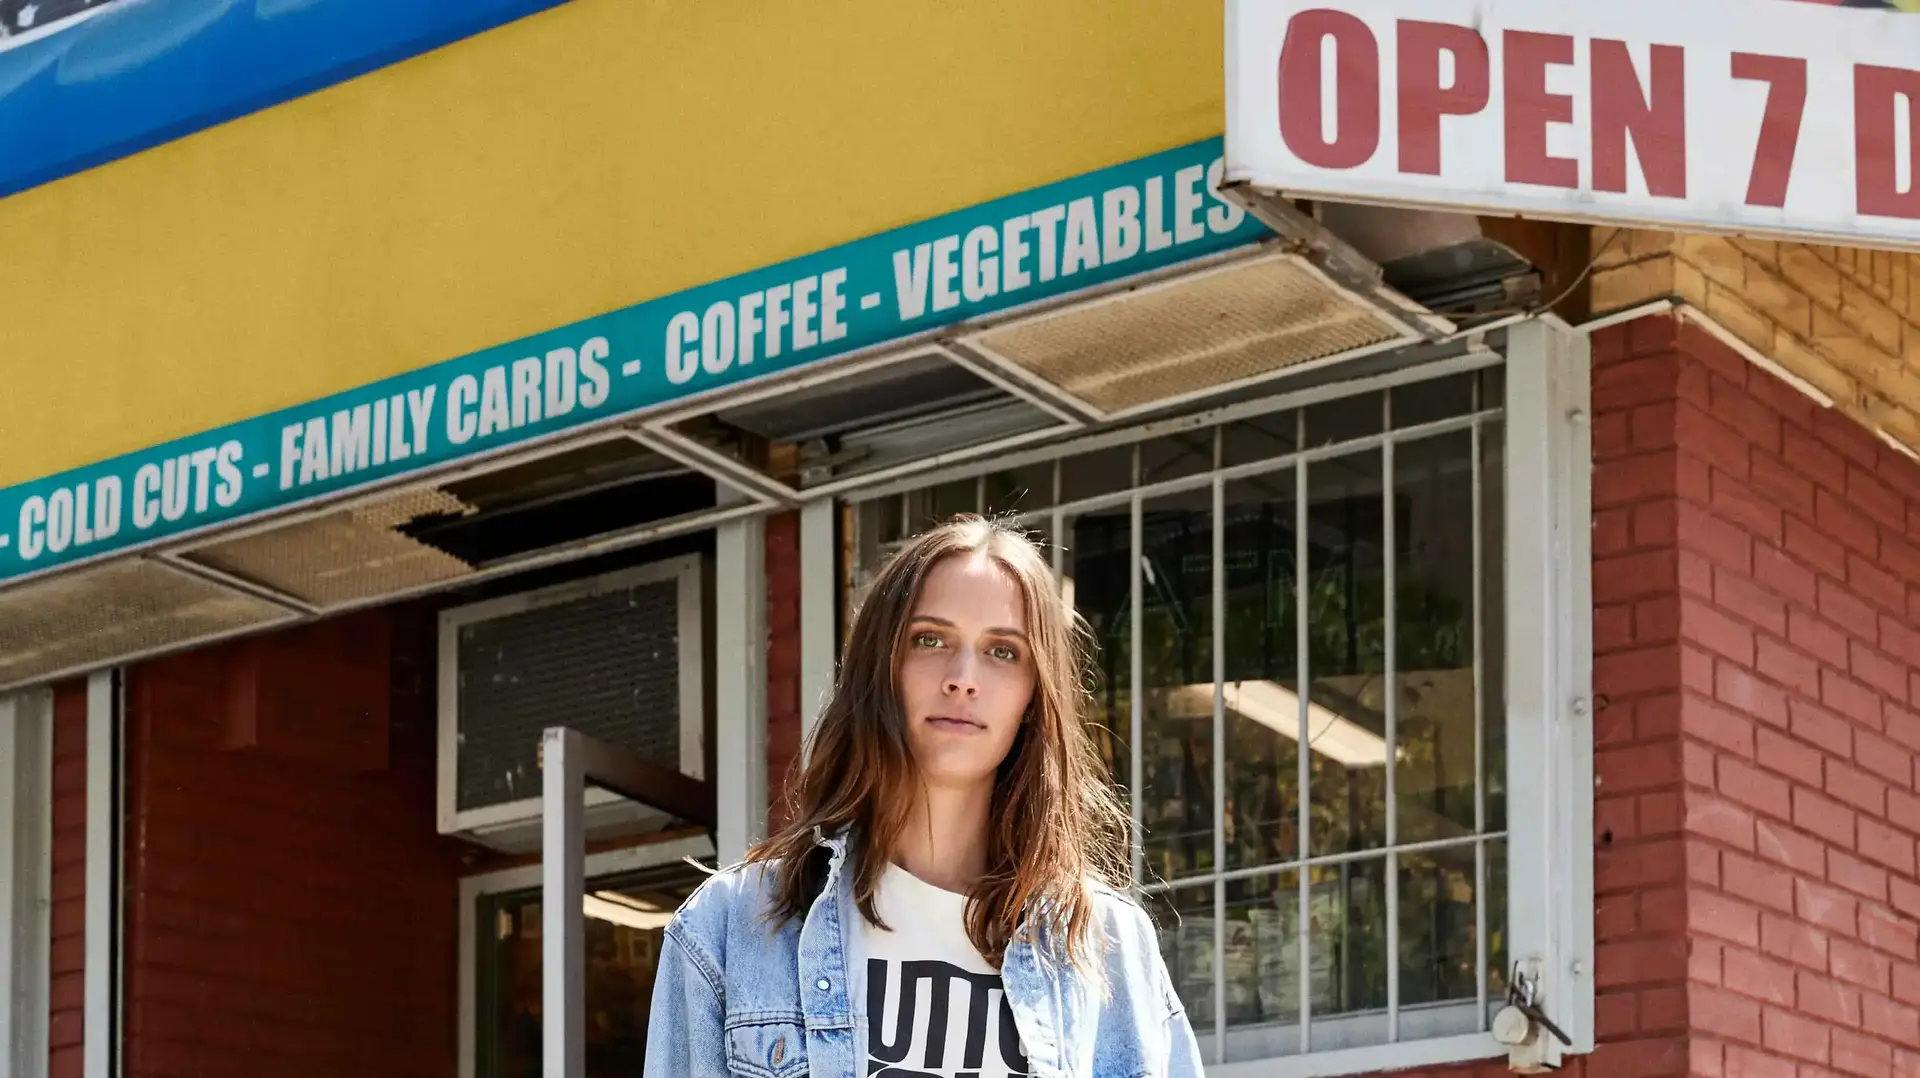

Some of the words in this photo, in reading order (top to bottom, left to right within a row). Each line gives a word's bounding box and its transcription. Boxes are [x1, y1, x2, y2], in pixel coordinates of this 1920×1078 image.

[1278, 8, 1686, 199] OPEN
[1730, 51, 1807, 209] 7
[18, 475, 122, 561] COLD
[132, 440, 243, 529] CUTS
[280, 385, 436, 491] FAMILY
[446, 336, 610, 445] CARDS
[665, 267, 848, 384] COFFEE
[893, 156, 1245, 321] VEGETABLES
